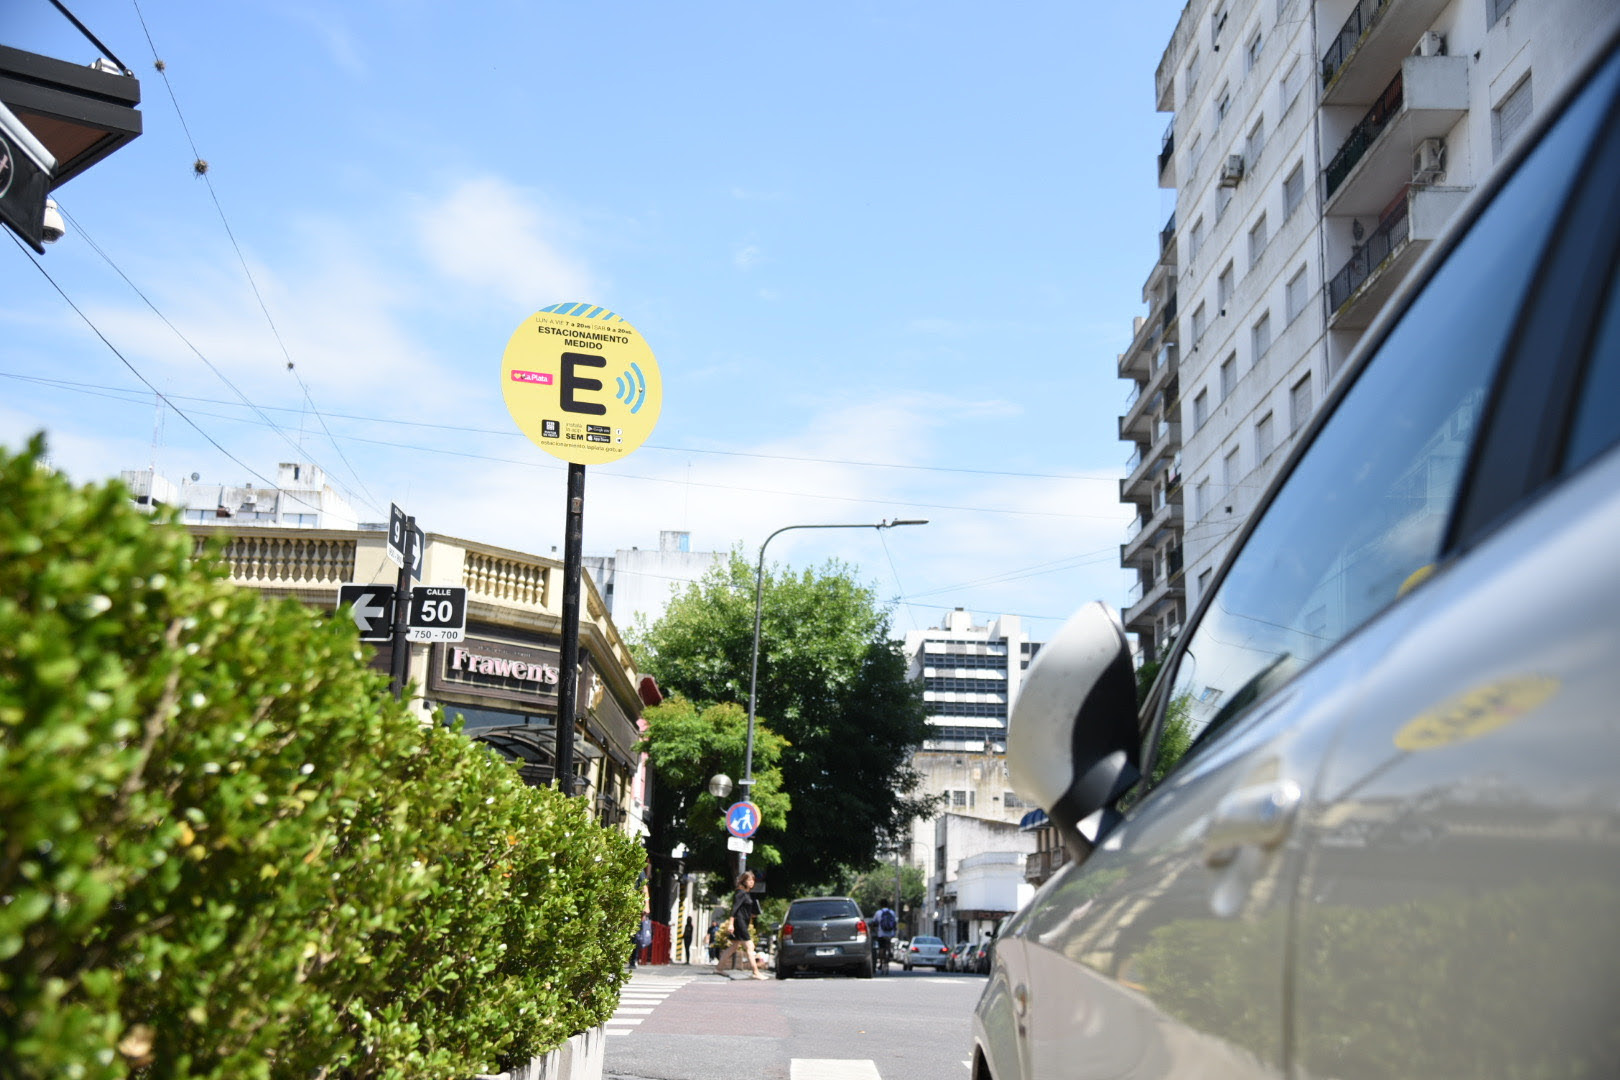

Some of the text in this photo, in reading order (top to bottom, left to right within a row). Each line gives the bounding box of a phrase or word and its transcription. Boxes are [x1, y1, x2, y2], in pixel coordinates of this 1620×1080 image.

[538, 325, 629, 345] ESTACIONAMIENTO
[564, 338, 603, 350] MEDIDO
[531, 373, 548, 383] Plata
[559, 351, 607, 416] E
[565, 433, 584, 441] SEM
[394, 521, 400, 543] 9
[426, 588, 452, 596] CALLE
[420, 600, 453, 623] 50
[414, 630, 432, 639] 750
[441, 631, 458, 640] 700
[452, 646, 559, 685] Frawen's
